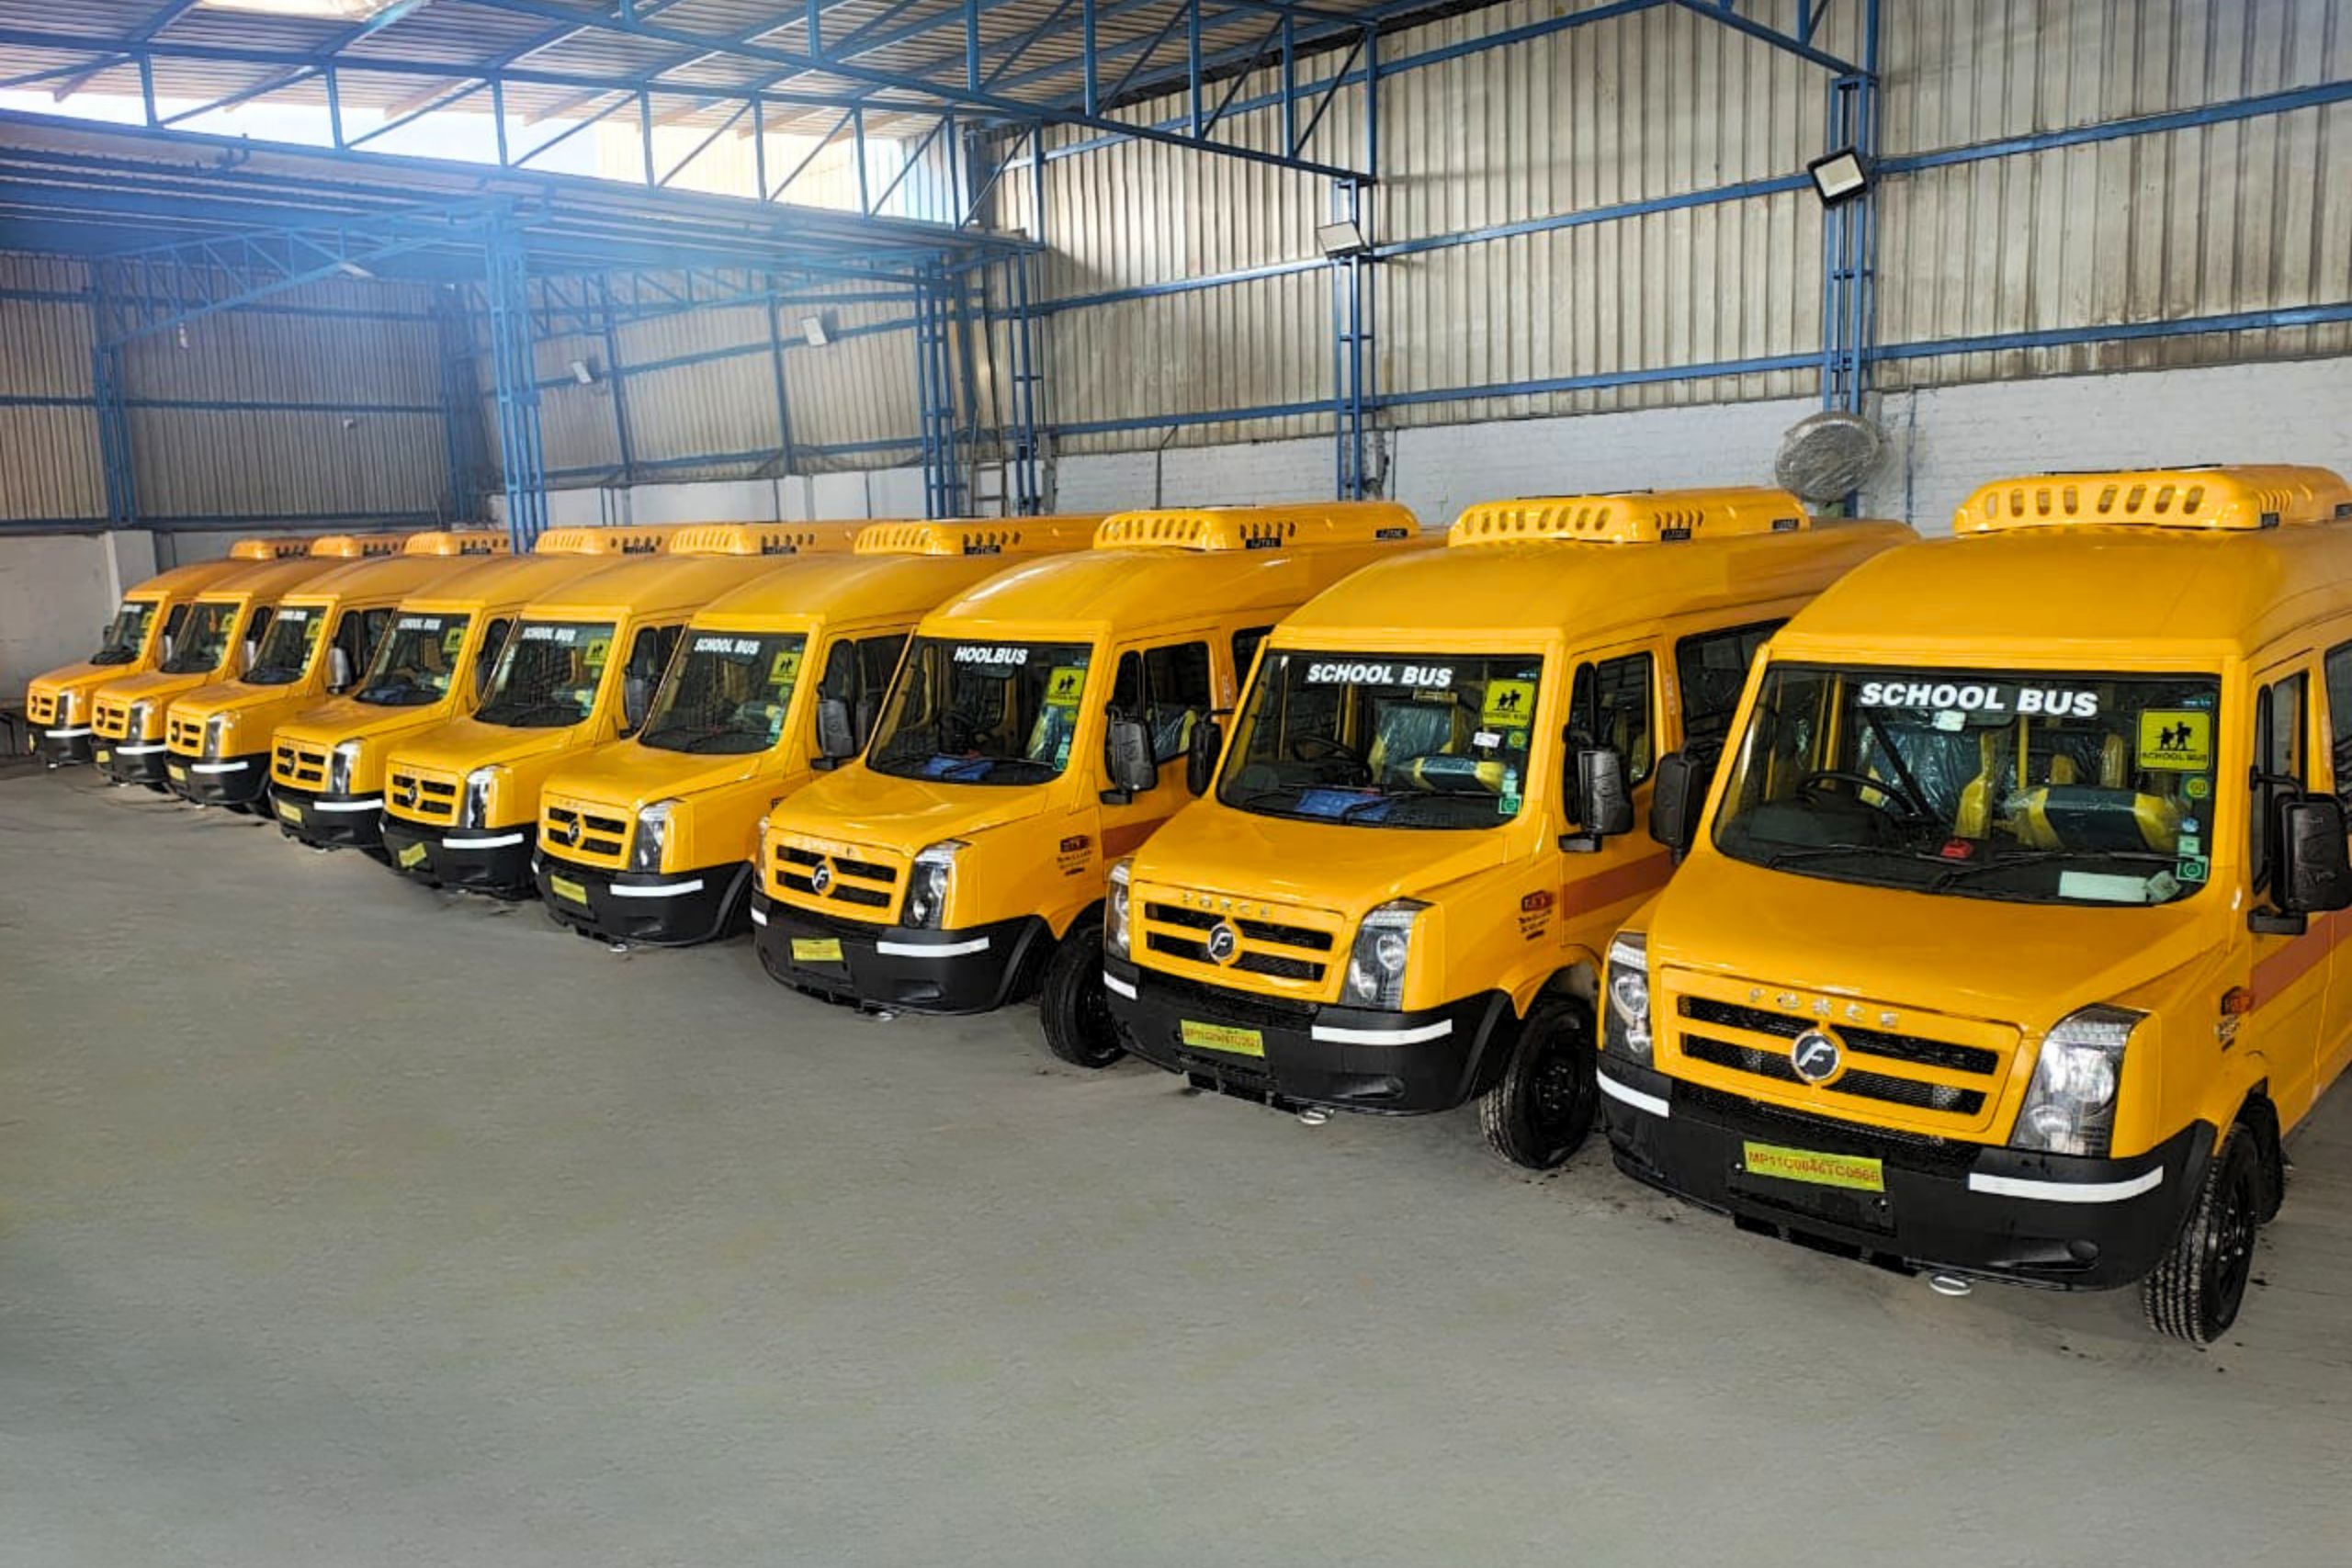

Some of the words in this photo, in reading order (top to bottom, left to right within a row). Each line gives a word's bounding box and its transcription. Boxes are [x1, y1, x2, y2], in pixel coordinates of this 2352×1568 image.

[694, 637, 734, 653] SCHOOL
[734, 639, 761, 655] BUS
[953, 646, 1028, 665] HOOLBUS
[1307, 663, 1394, 683] SCHOOL
[1401, 666, 1453, 687] BUS
[1860, 682, 2006, 709] SCHOOL
[2017, 689, 2099, 717] BUS
[1748, 987, 1899, 1028] FORCE
